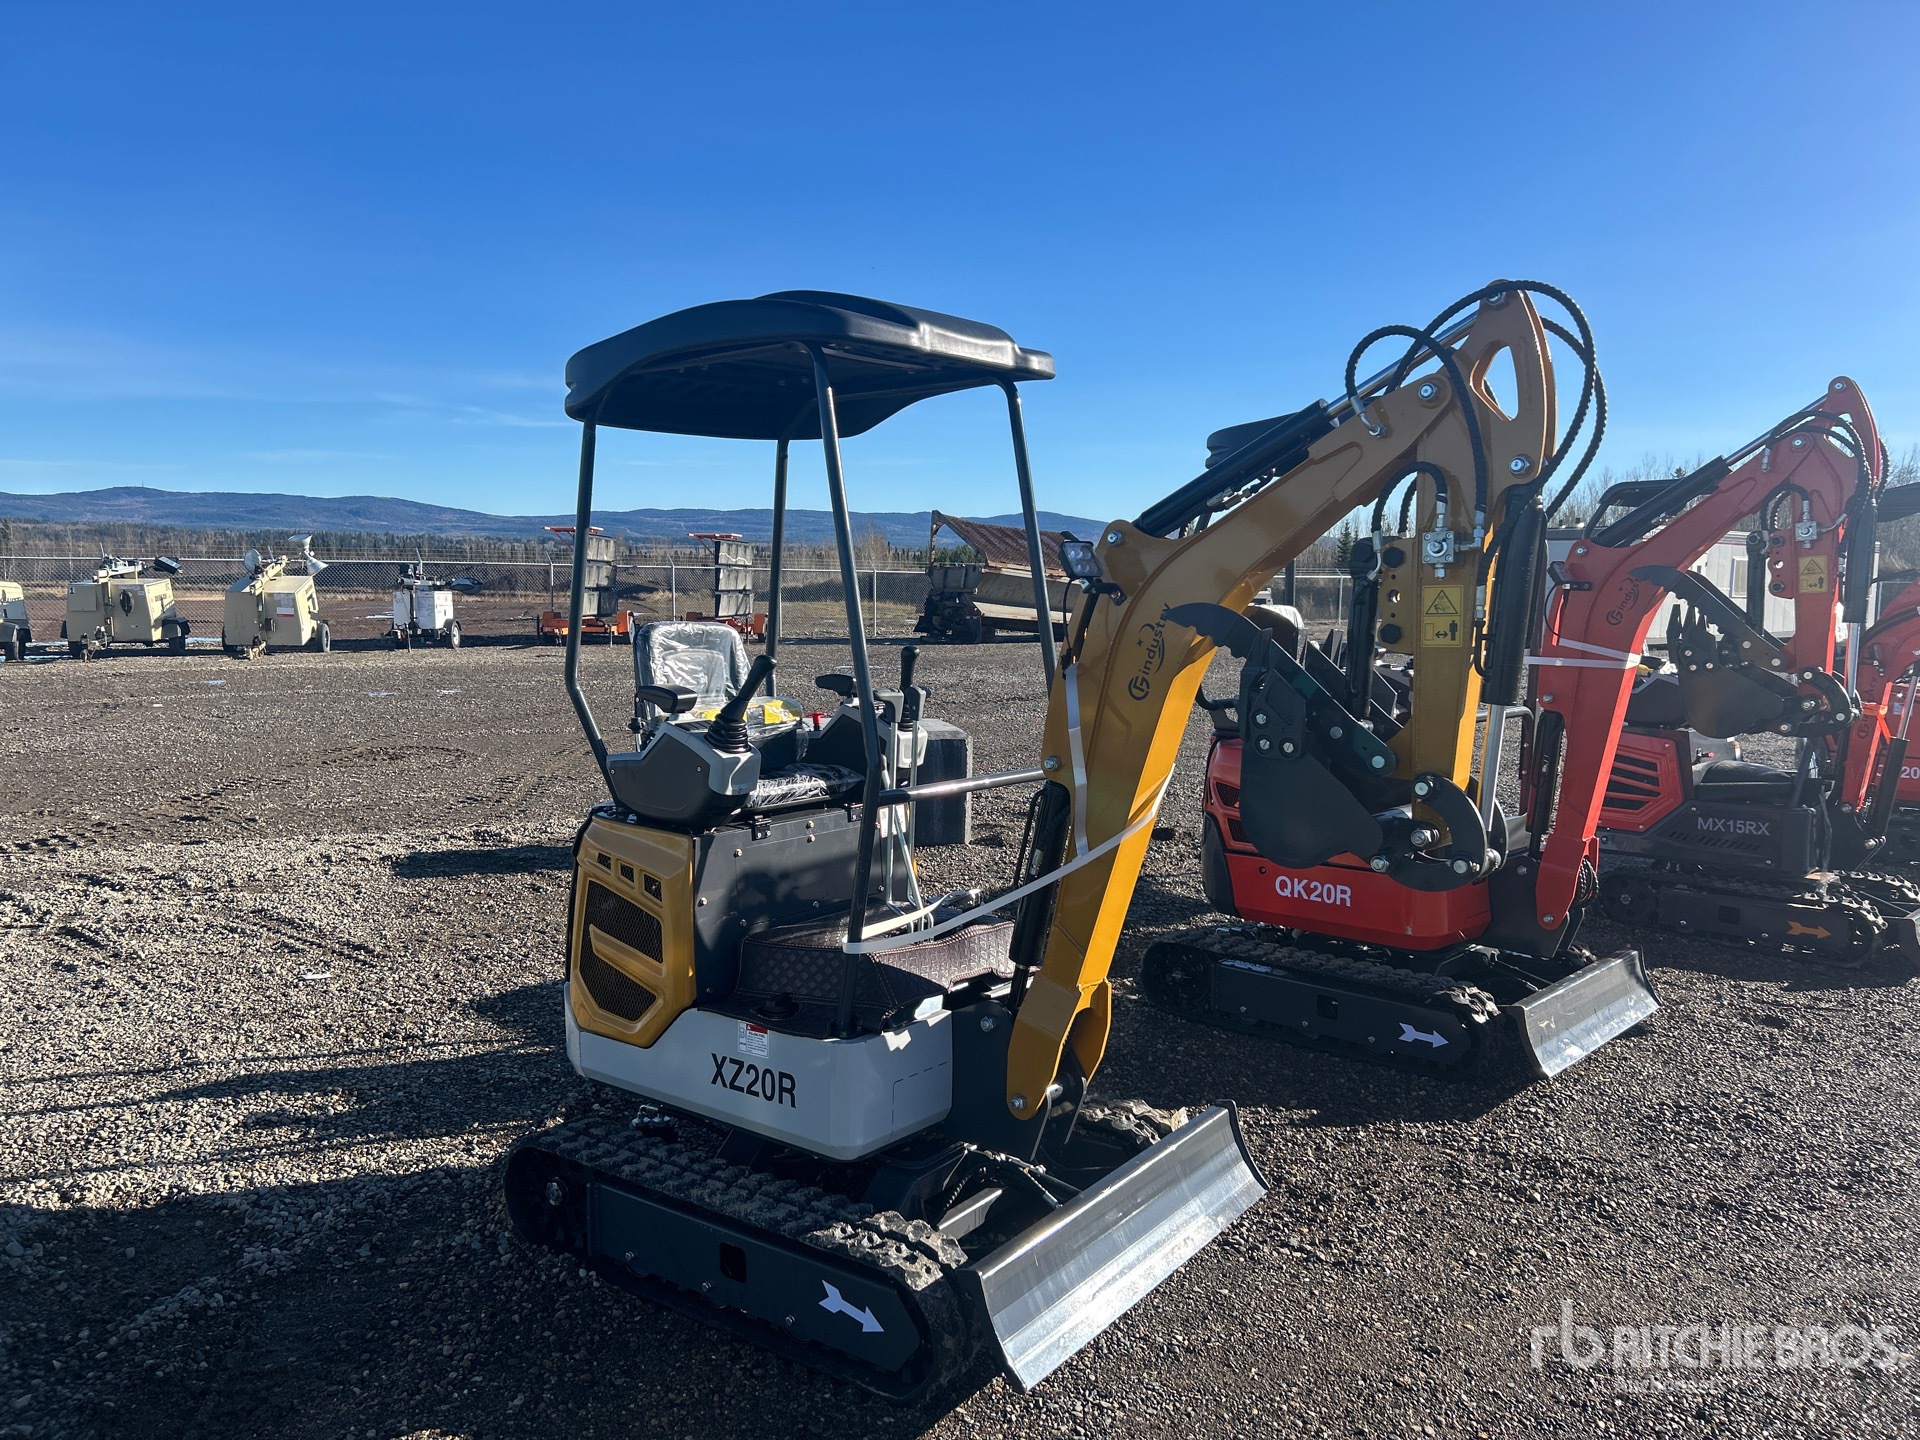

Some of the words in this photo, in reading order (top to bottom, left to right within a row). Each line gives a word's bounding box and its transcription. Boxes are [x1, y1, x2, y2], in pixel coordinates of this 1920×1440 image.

[1697, 817, 1770, 836] MX15RX
[1275, 875, 1352, 907] QK20R
[710, 1052, 797, 1109] XZ20R
